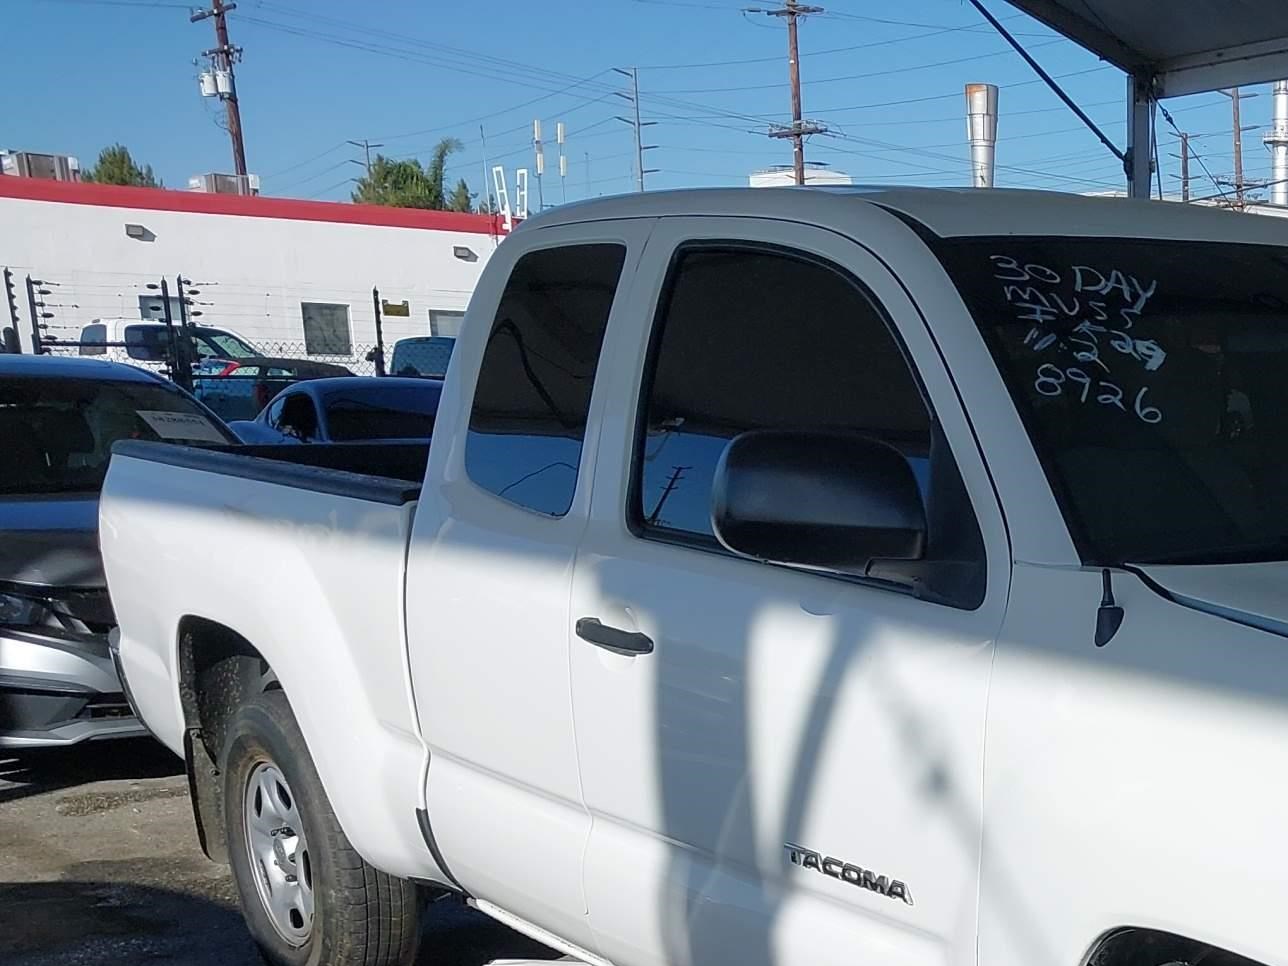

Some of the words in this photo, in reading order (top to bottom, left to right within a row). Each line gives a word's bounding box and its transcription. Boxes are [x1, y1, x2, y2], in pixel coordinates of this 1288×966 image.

[989, 254, 1062, 284] 30
[1072, 264, 1158, 310] DAY
[1034, 363, 1163, 424] 8926
[784, 841, 915, 906] TACOMA
